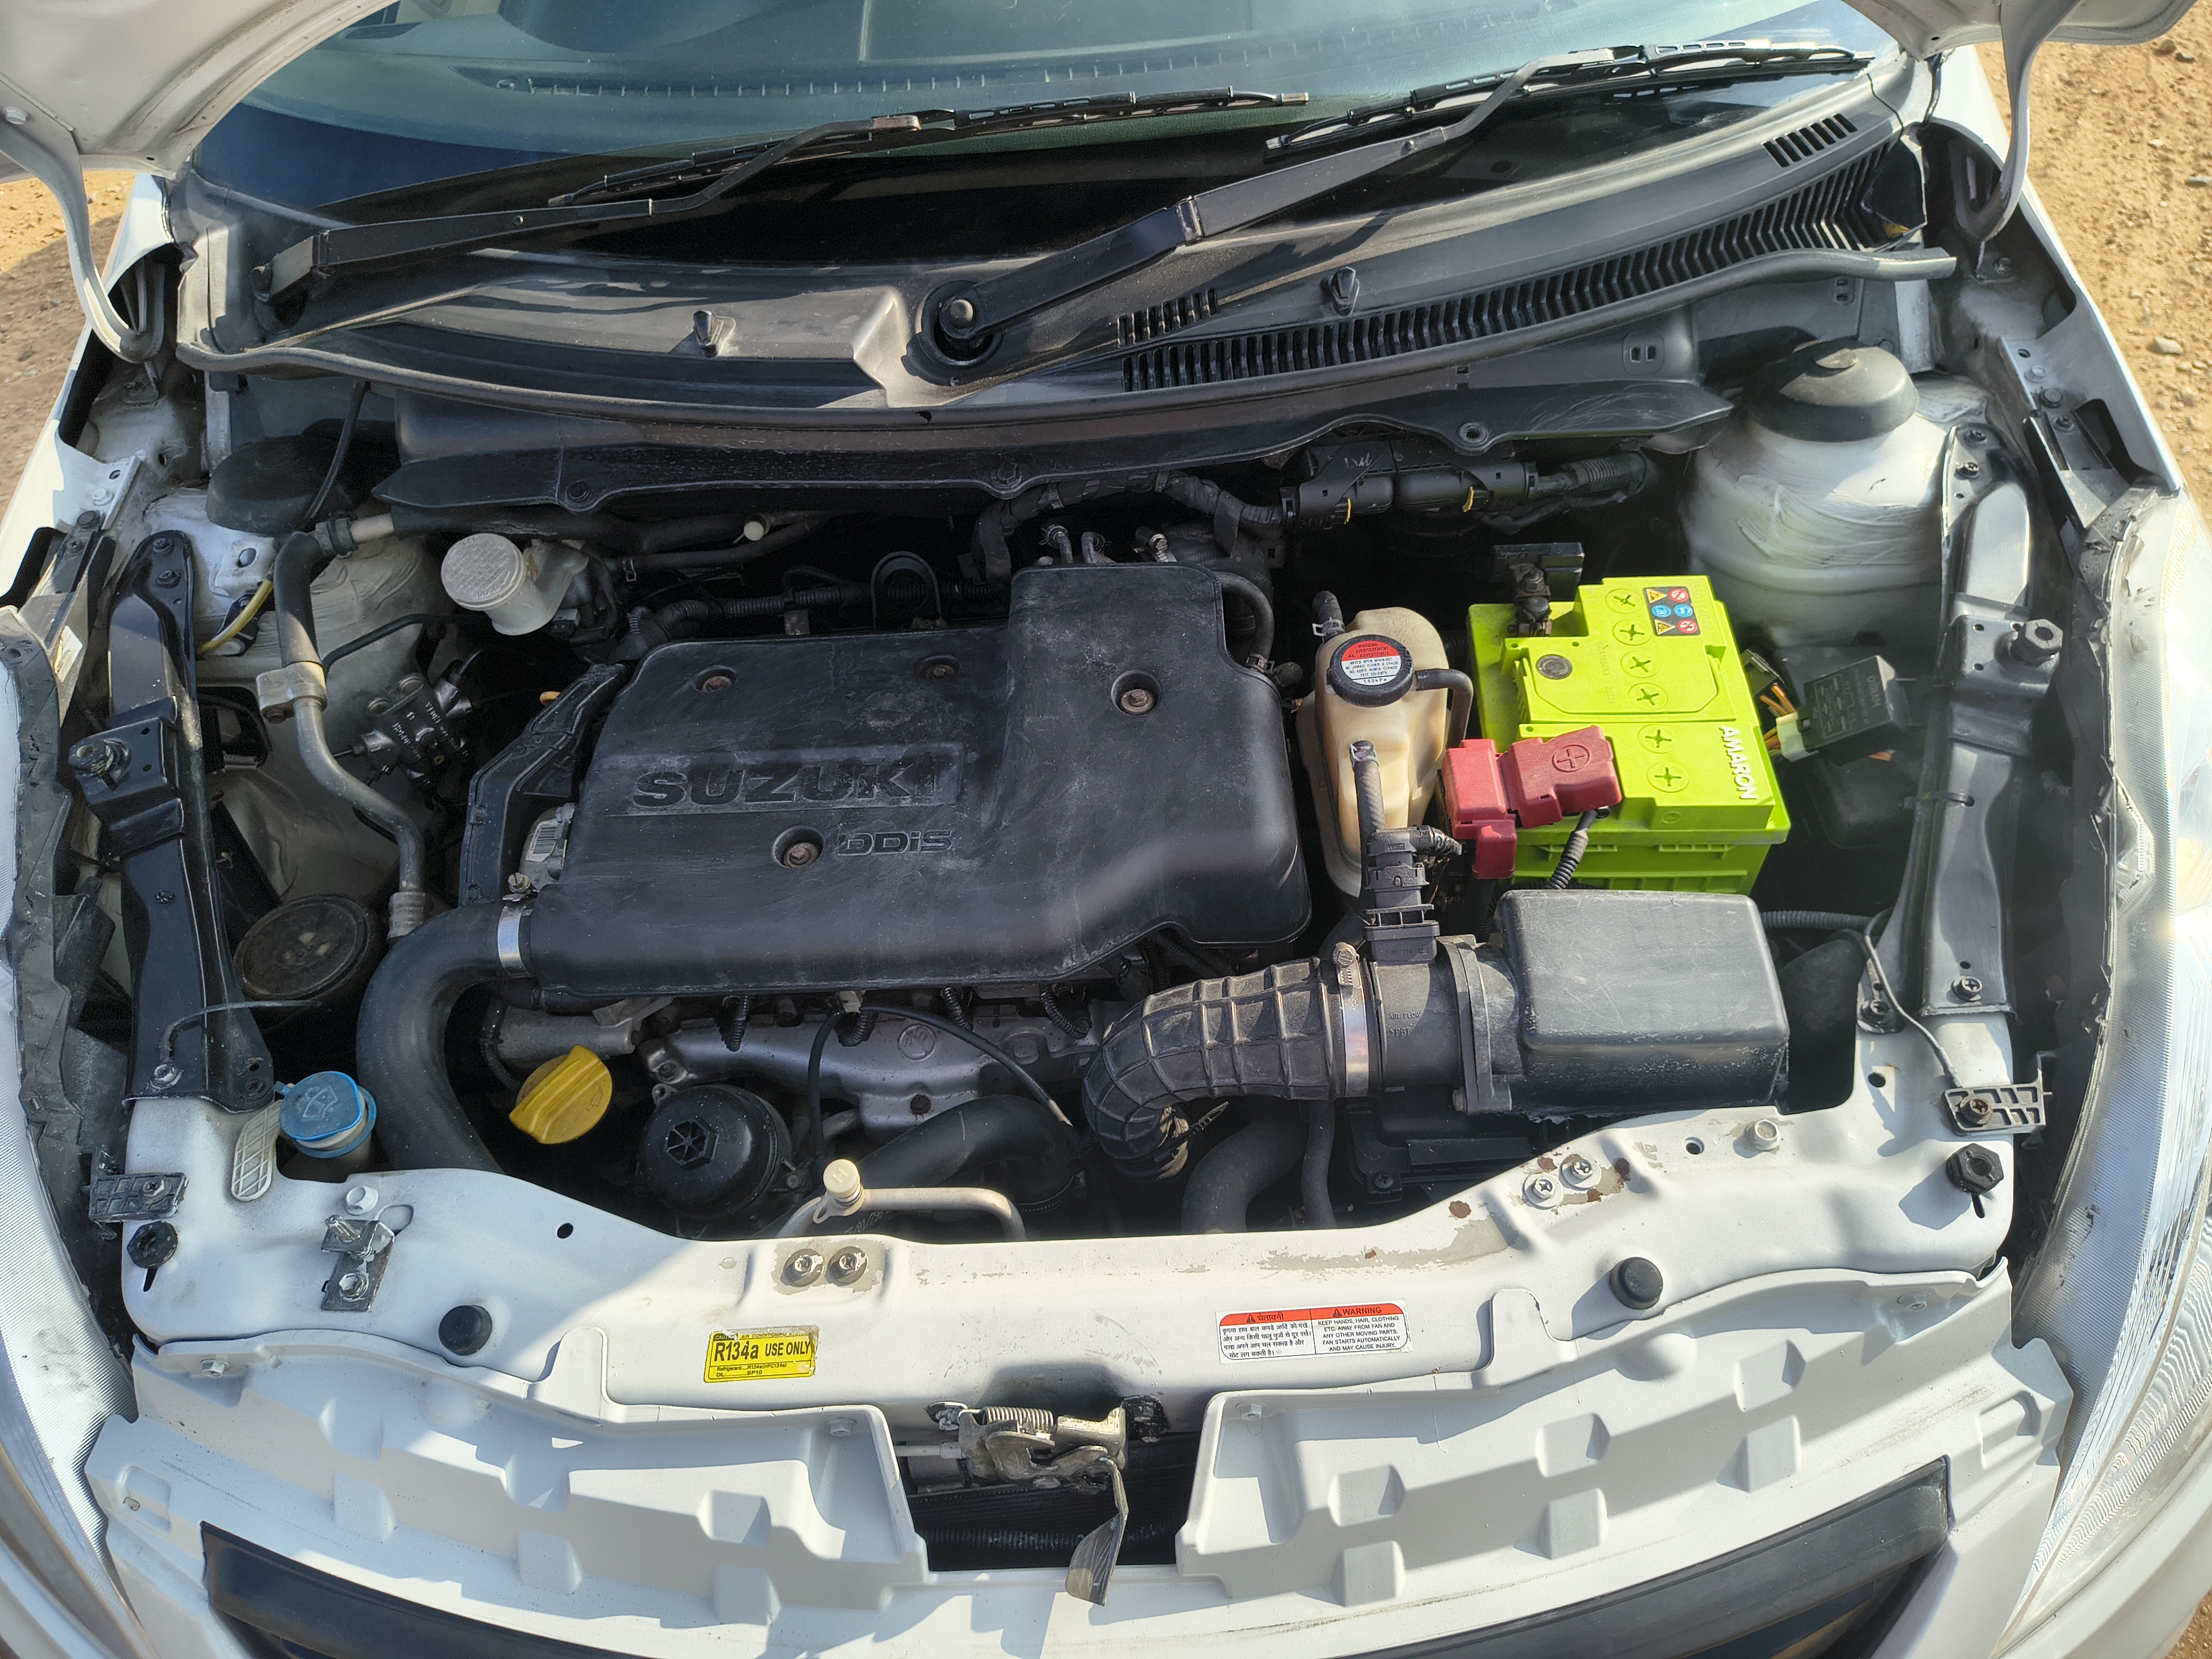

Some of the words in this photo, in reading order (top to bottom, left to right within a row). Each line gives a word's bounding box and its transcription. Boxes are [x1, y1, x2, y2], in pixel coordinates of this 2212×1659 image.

[1719, 726, 1759, 800] AMARON
[632, 753, 939, 808] SUZUKI
[838, 830, 952, 857] DDiS
[831, 1168, 849, 1184] H
[1257, 1312, 1284, 1321] चेतावनी
[1343, 1307, 1382, 1316] WARNING
[714, 1340, 759, 1361] R134a
[765, 1343, 784, 1357] USE
[786, 1341, 811, 1355] ONLY
